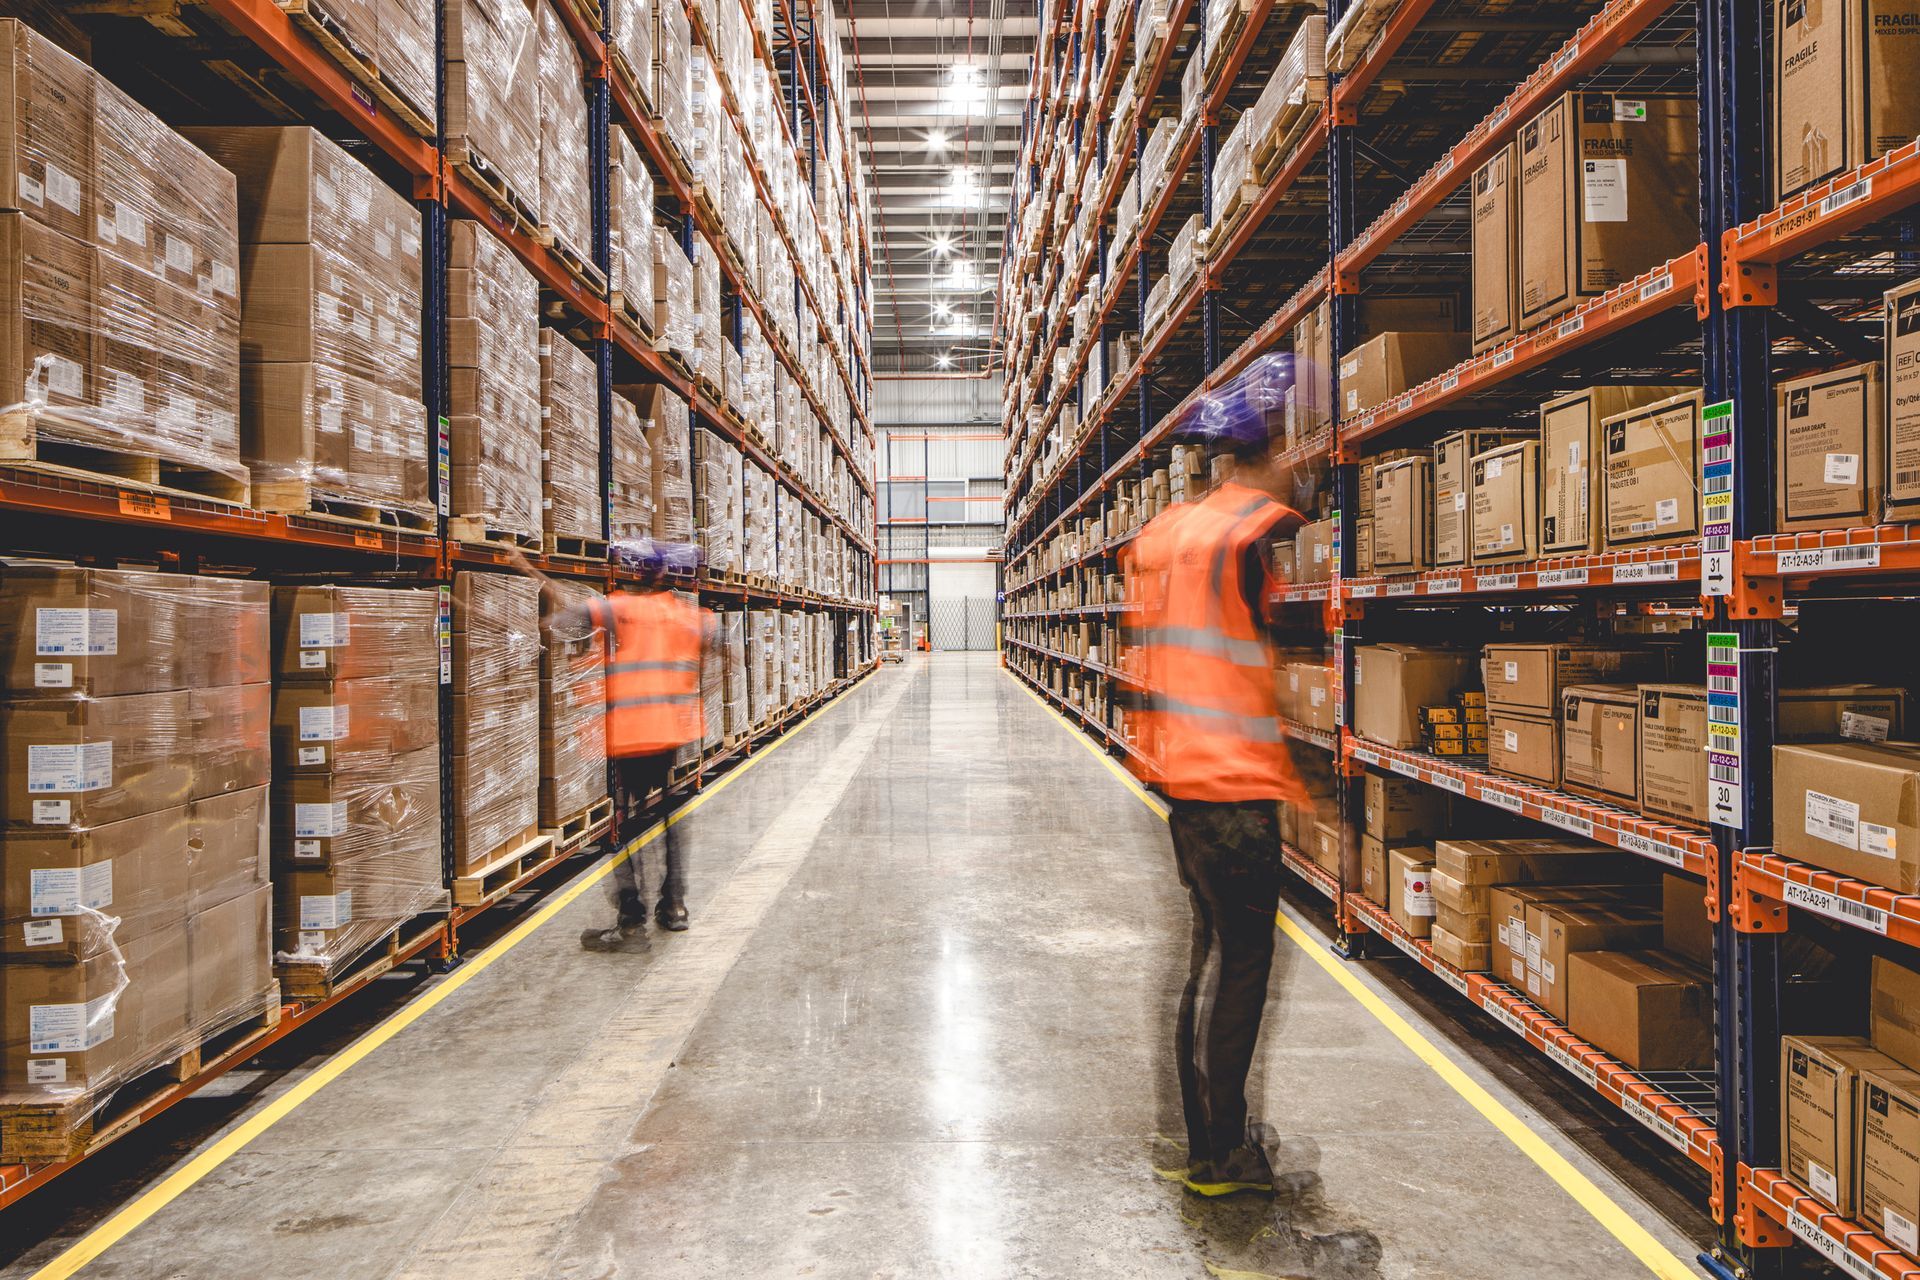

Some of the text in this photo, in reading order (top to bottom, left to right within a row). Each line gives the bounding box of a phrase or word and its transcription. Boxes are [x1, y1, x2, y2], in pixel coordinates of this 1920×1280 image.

[1875, 28, 1897, 36] MIXED
[1784, 41, 1818, 72] FRAGILE
[1584, 138, 1633, 150] FRAGILE
[1524, 155, 1548, 181] FRAGILE
[1476, 199, 1495, 219] FRAGILE
[1774, 208, 1817, 238] AT-12-B1-91
[1898, 355, 1912, 366] REF
[1789, 422, 1827, 435] HEAD BAR DRAPE
[1705, 495, 1730, 505] AT-12-D-31
[1705, 525, 1729, 536] AT-12-C-31
[1710, 557, 1721, 573] 31
[1781, 553, 1824, 568] AT-12-A3-91
[1615, 568, 1643, 579] AT-12-A3-90
[1710, 724, 1737, 736] AT-12-D-30
[1710, 754, 1738, 767] AT-12-C-30
[1718, 786, 1730, 803] 30
[1620, 834, 1649, 851] AT-12-A2-90
[1787, 886, 1830, 910] AT-12-A2-91
[1867, 1120, 1893, 1140] FEEDING KIT
[1867, 1128, 1920, 1164] WITH FLAT TOP SYRINGE
[1791, 1215, 1835, 1255] AT-12-A1-91
